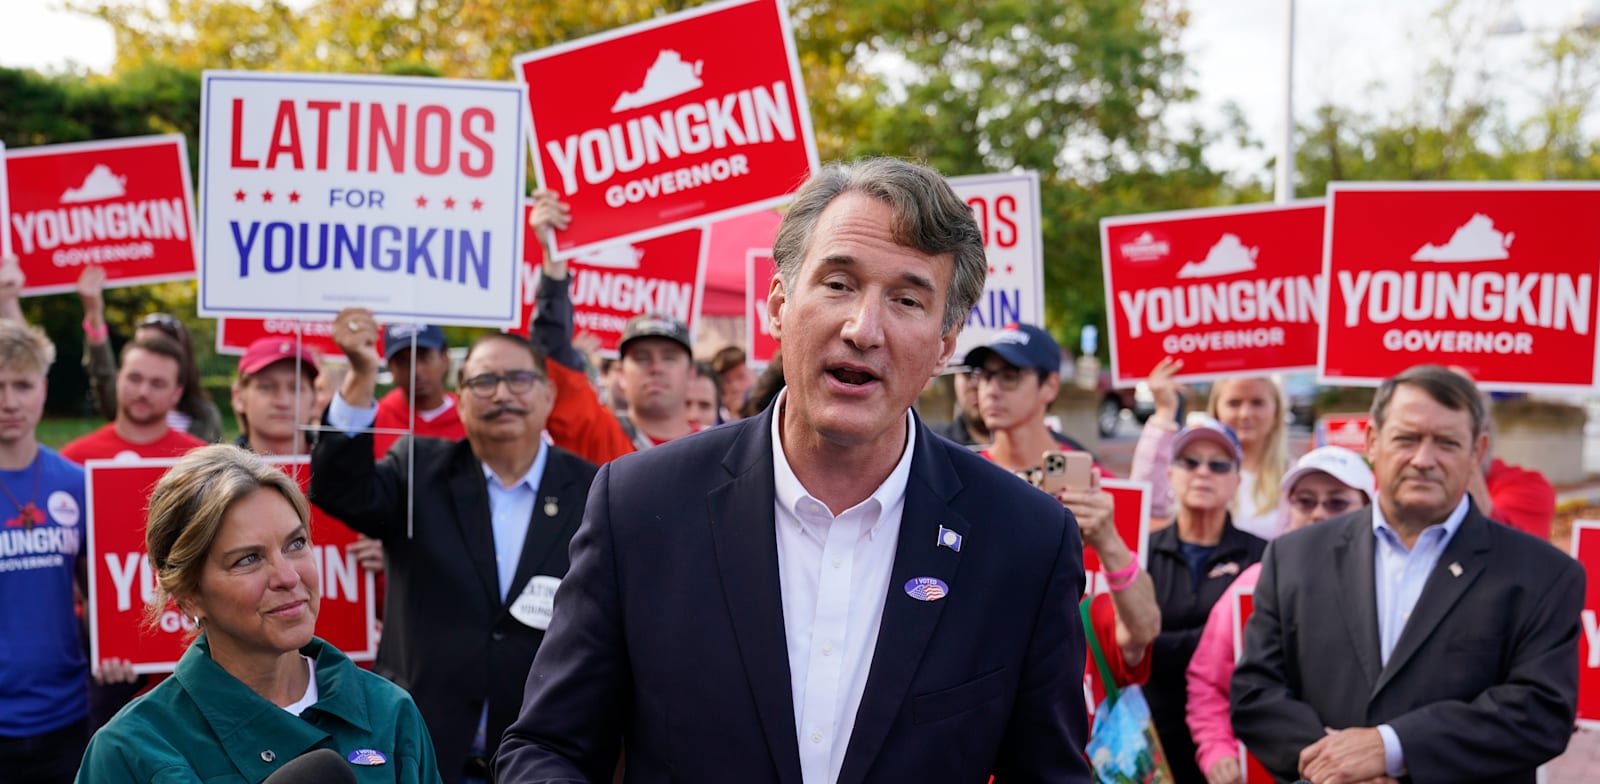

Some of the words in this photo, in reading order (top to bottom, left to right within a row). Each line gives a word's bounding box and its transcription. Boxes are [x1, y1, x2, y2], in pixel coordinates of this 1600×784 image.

[230, 98, 495, 178] LATINOS
[545, 81, 796, 196] YOUNGKIN
[329, 189, 385, 208] FOR
[605, 154, 749, 208] GOVERNOR
[12, 197, 188, 254] YOUNGKIN
[52, 242, 155, 267] GOVERNOR
[229, 220, 491, 290] YOUNGKIN
[522, 262, 692, 328] YUNGKIN
[1118, 274, 1322, 338] YOUNGKIN
[1338, 270, 1593, 335] YOUNGKIN
[1163, 327, 1285, 354] GOVERNOR
[1383, 328, 1533, 354] GOVERNOR
[0, 526, 79, 558] UNGKIN
